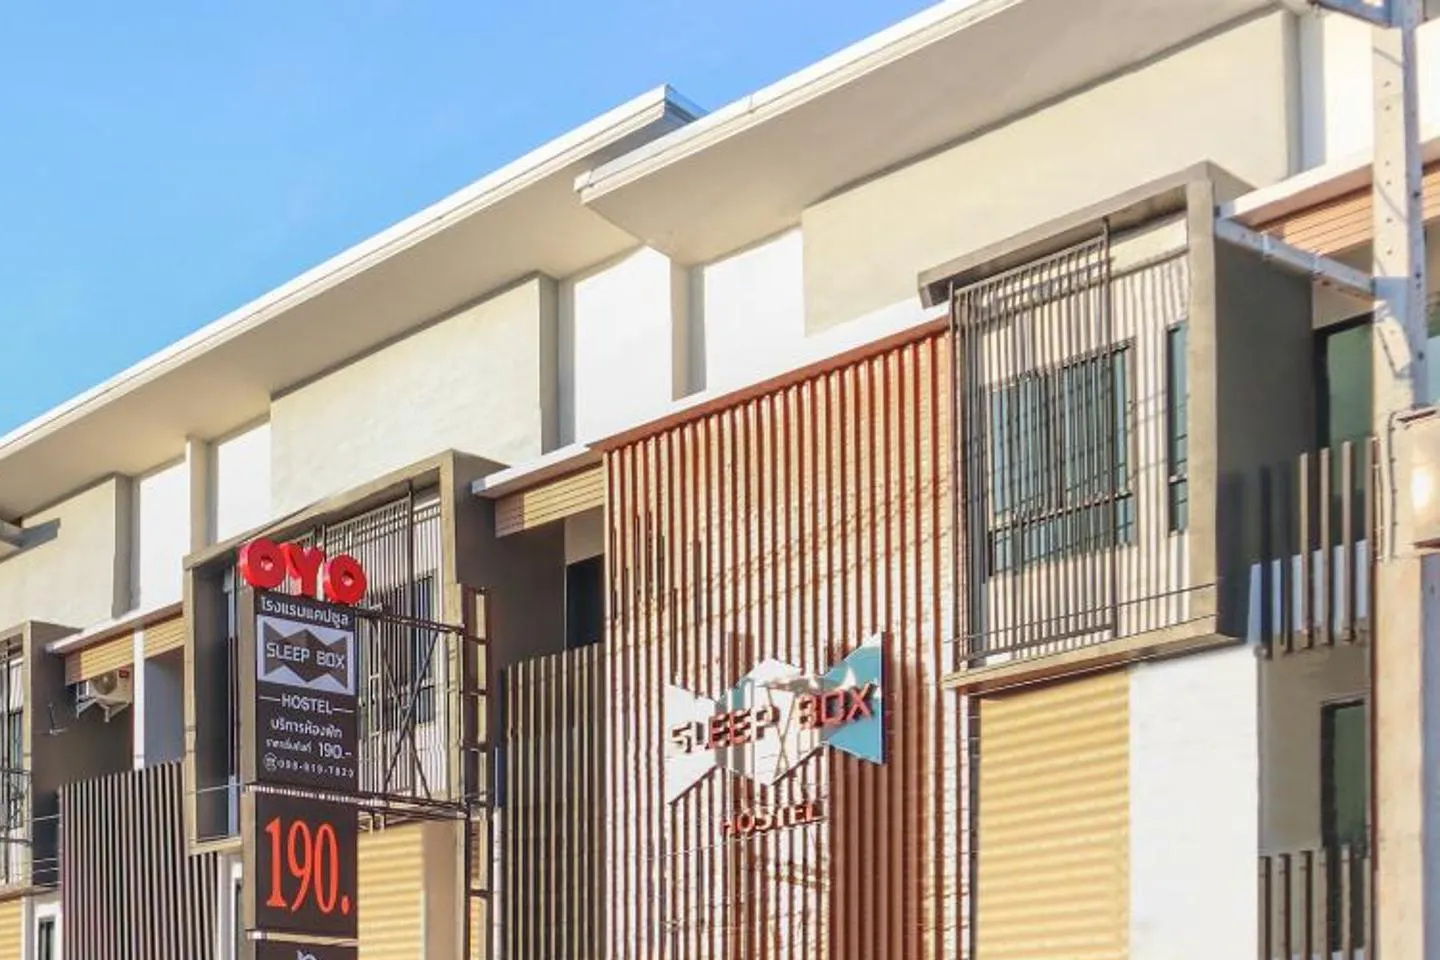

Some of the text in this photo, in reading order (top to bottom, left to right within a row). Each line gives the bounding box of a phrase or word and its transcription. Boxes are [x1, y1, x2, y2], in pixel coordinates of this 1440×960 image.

[238, 536, 367, 605] OYO
[266, 642, 345, 669] SLEEP BOX
[282, 694, 333, 715] HOSTEL
[671, 682, 877, 753] SLEEP BOX
[721, 803, 819, 838] HOSTEL
